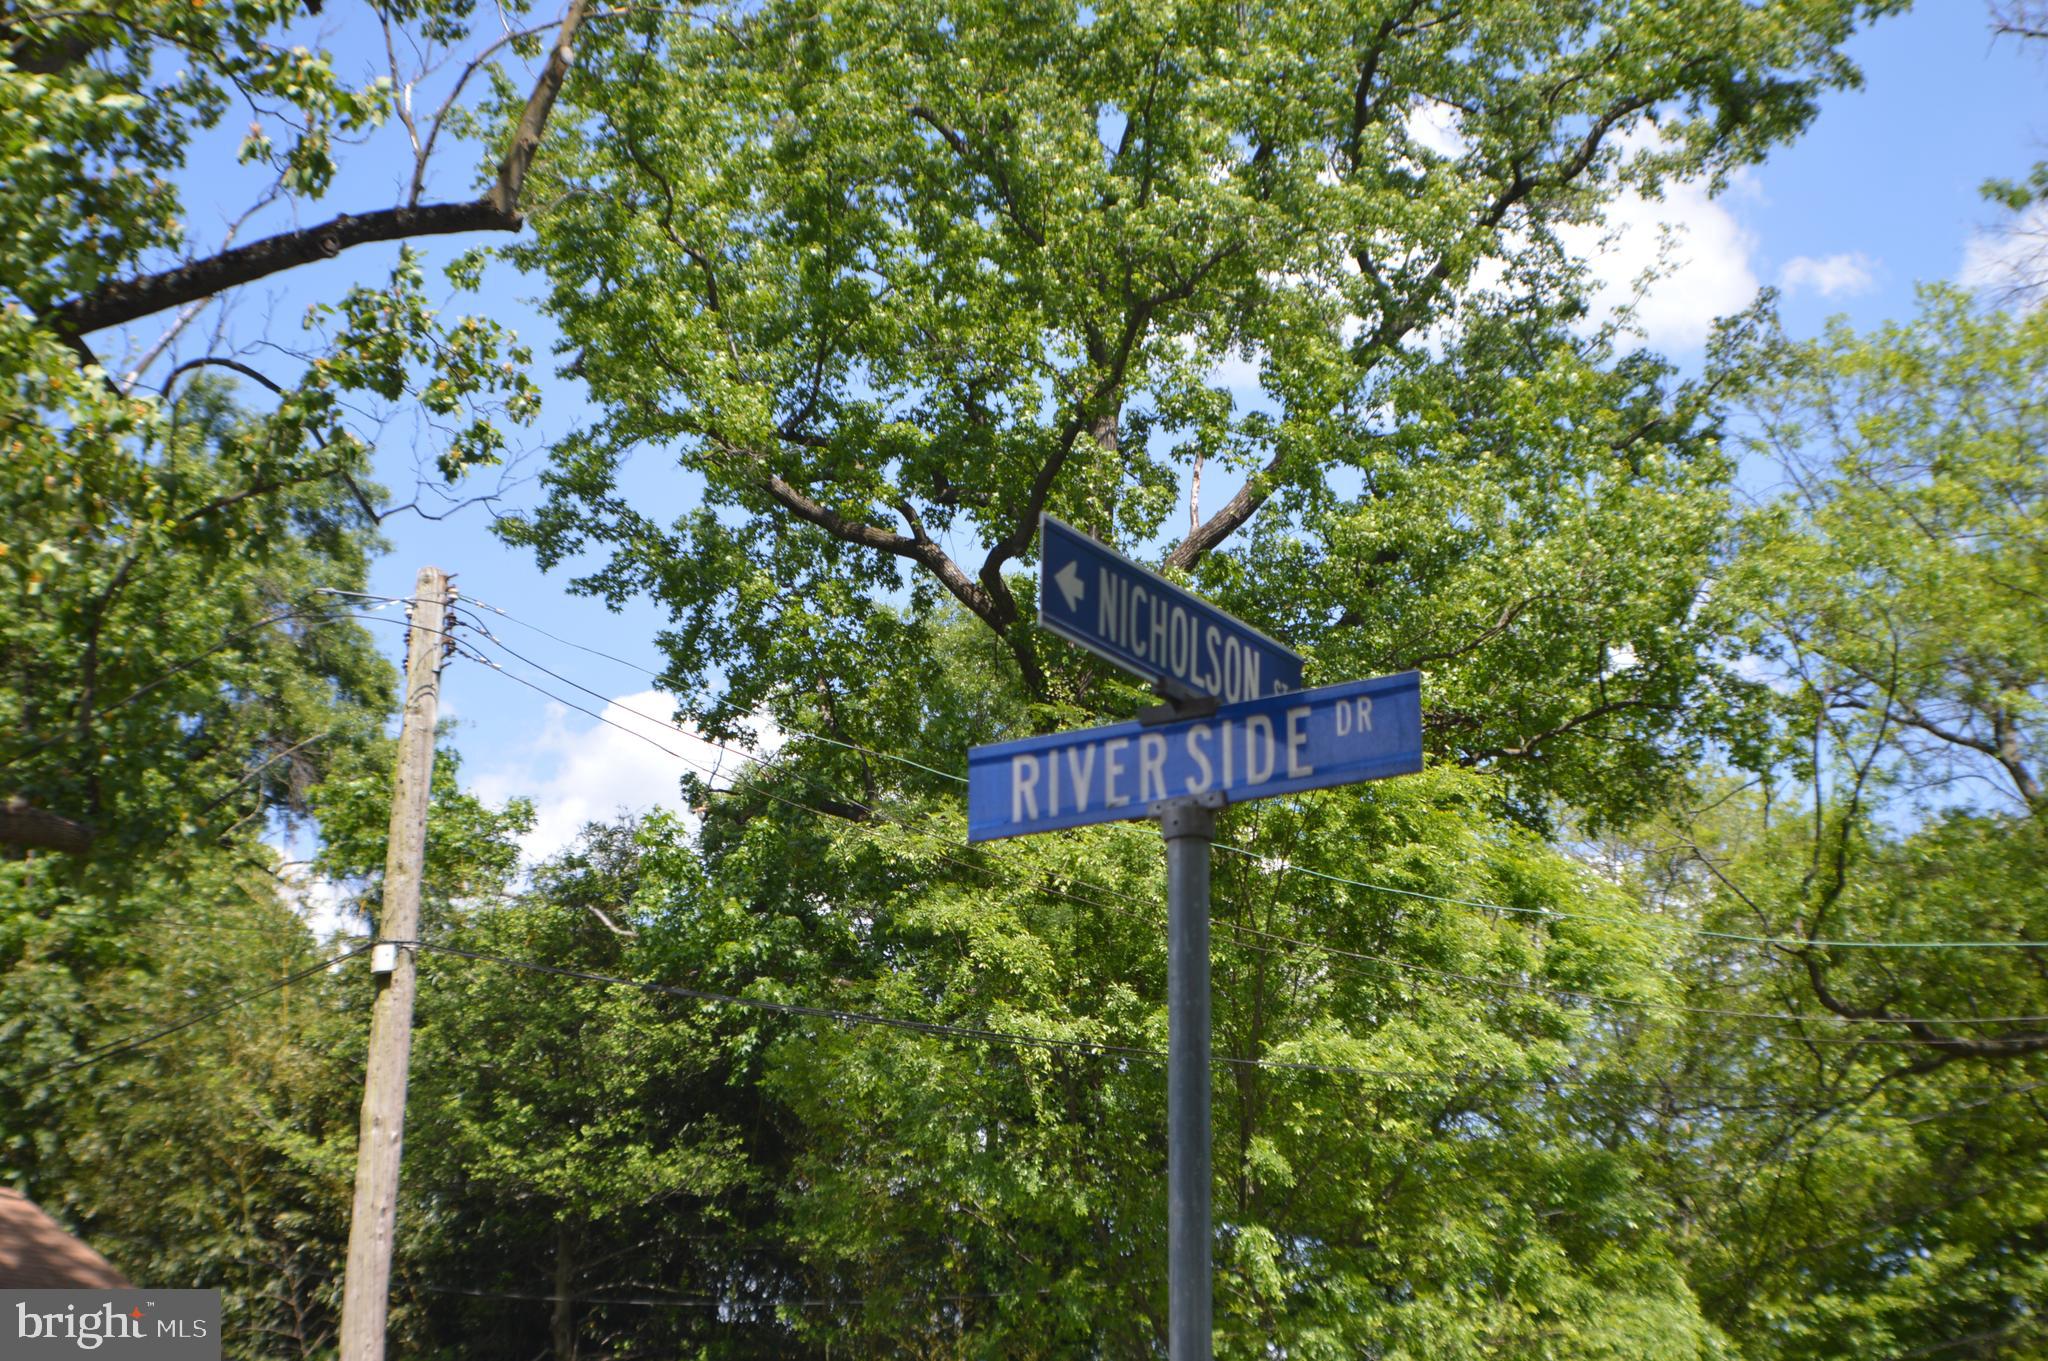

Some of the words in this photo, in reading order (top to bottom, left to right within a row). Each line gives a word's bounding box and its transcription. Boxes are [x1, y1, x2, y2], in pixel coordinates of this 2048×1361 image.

[1099, 567, 1260, 704] NICHOLSON
[1012, 706, 1314, 823] RIVERSIDE
[1336, 696, 1373, 737] DR
